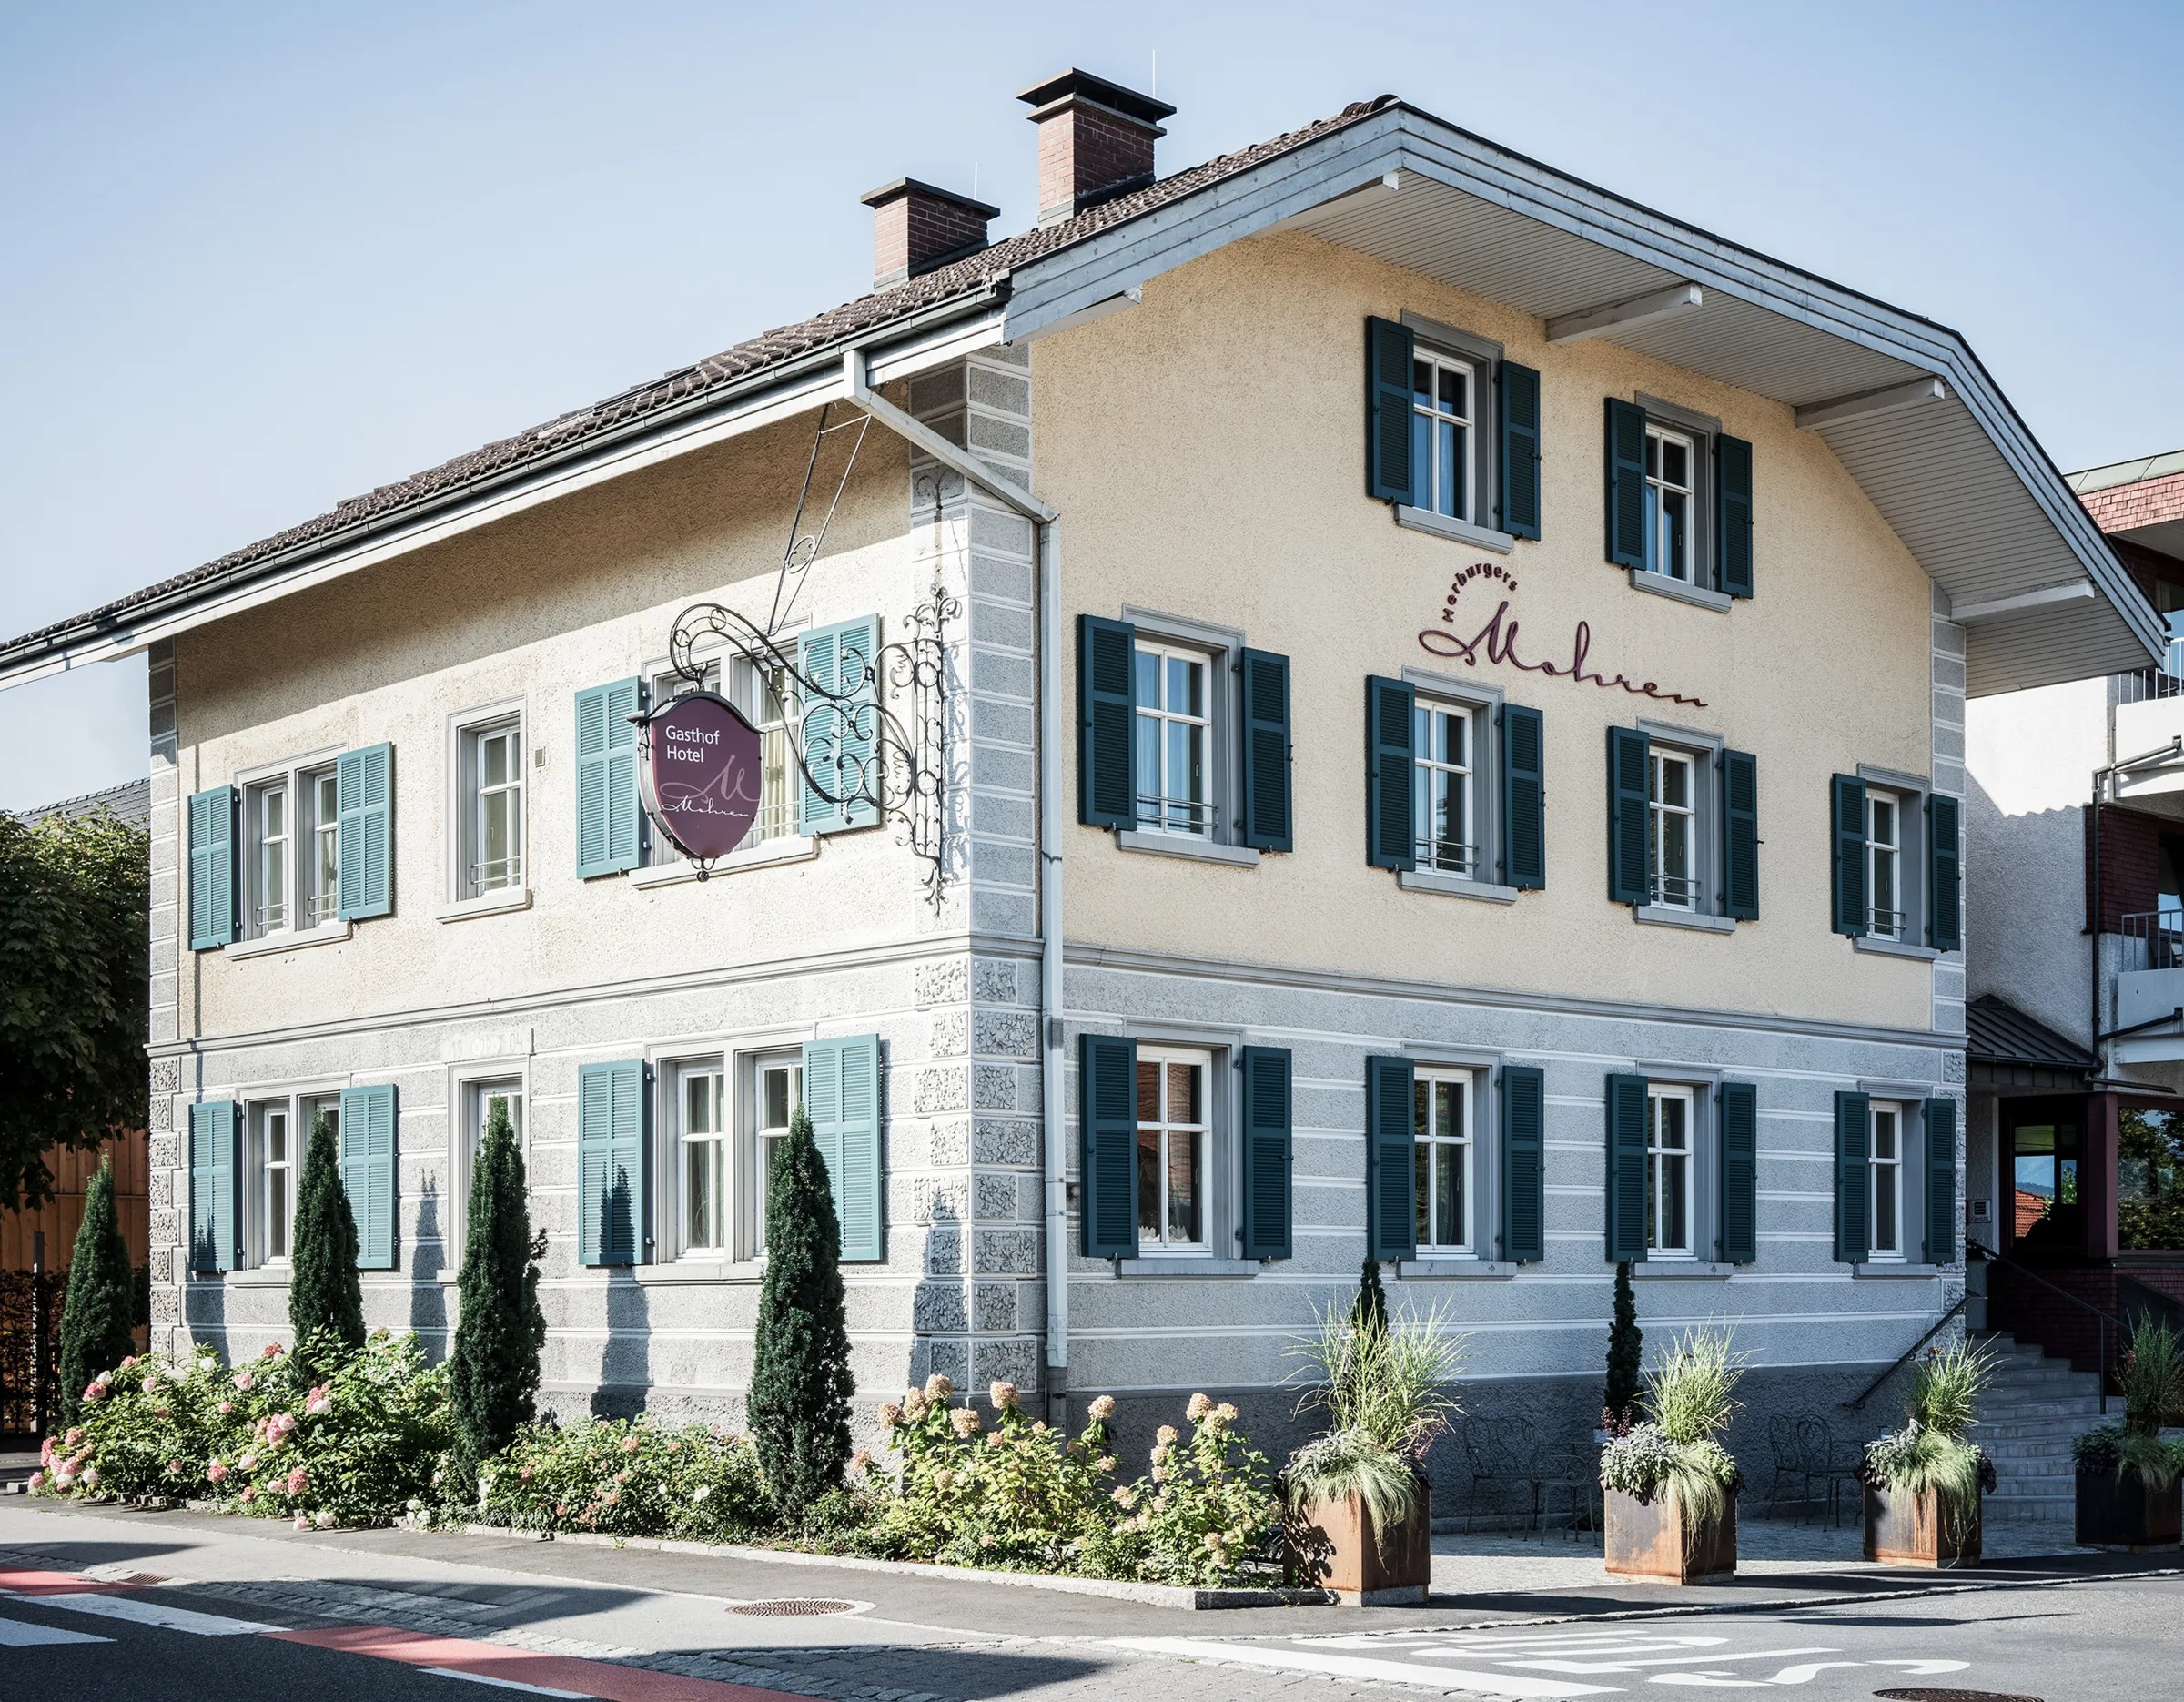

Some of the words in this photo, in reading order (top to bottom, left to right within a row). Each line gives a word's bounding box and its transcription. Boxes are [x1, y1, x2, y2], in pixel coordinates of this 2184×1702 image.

[1441, 562, 1519, 623] Herburgers
[1418, 601, 1709, 707] Mohren
[665, 725, 721, 745] Gasthof
[667, 745, 704, 763] Hotel
[662, 795, 751, 817] Mohren
